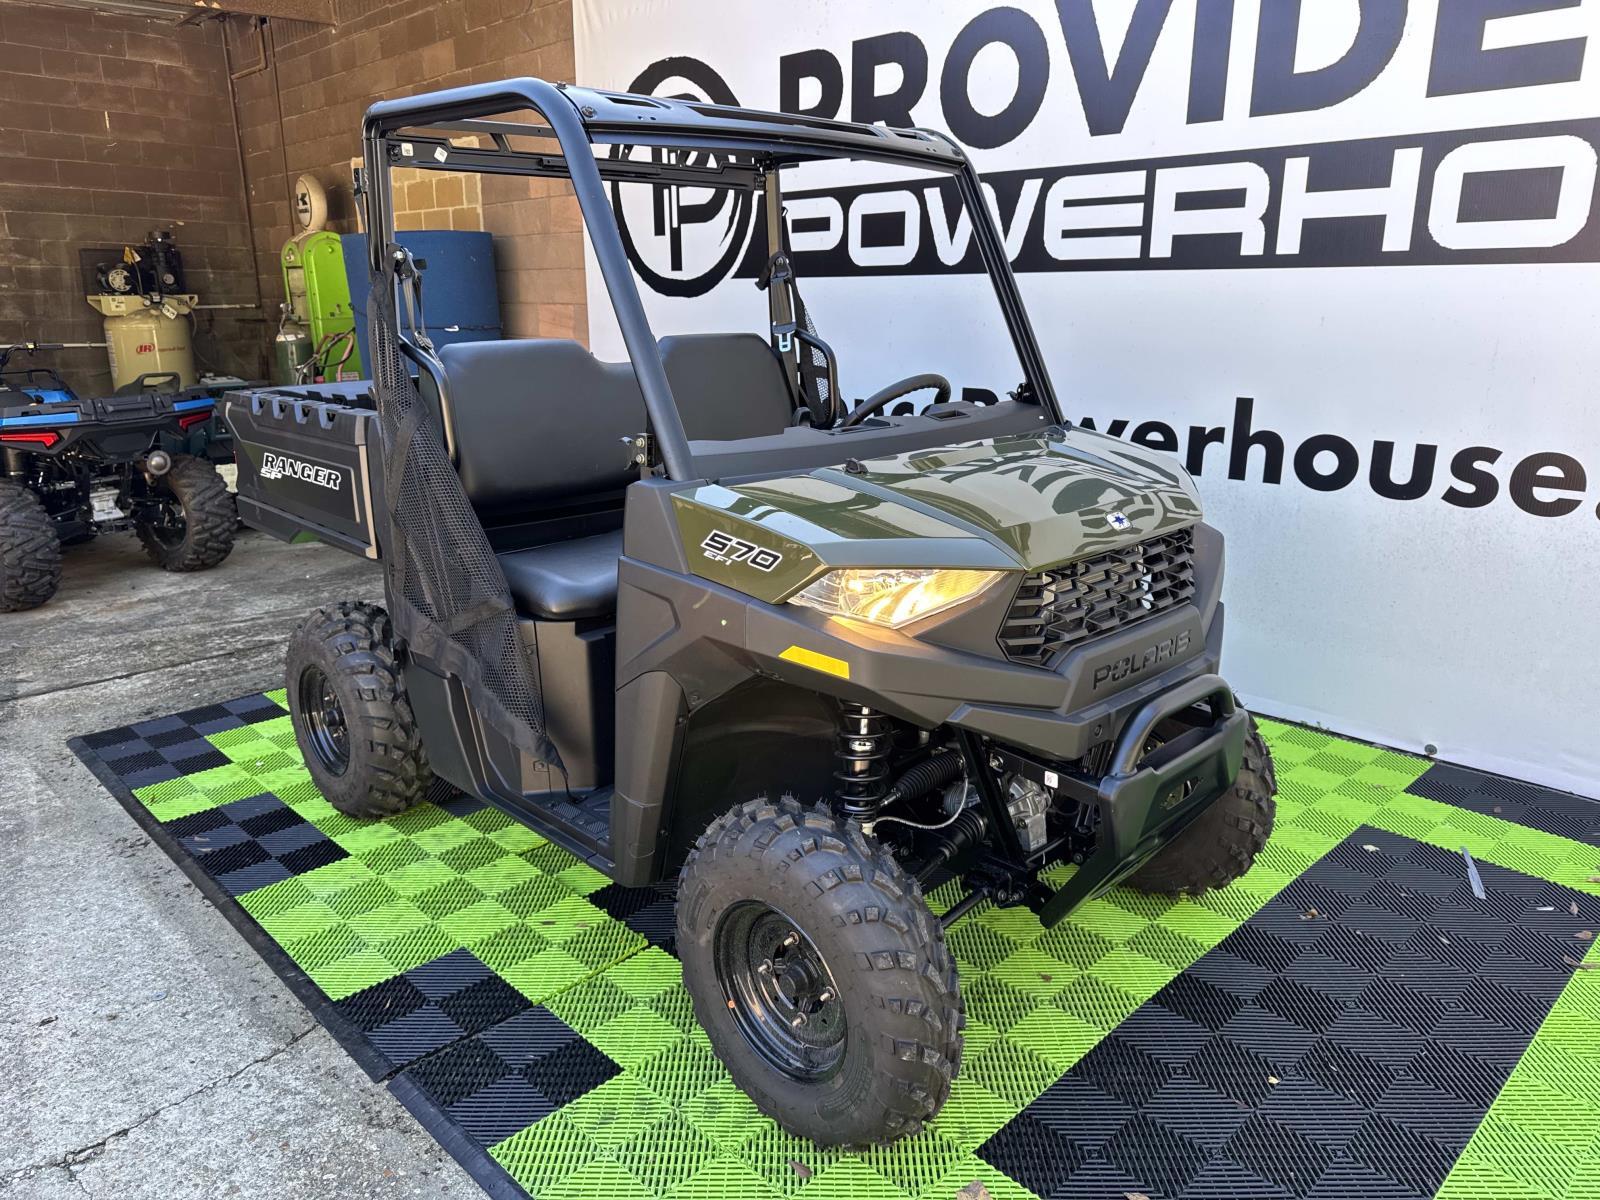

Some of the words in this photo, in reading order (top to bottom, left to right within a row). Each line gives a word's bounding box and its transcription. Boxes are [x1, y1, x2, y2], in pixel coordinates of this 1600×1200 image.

[780, 0, 1588, 168] PROVIDE
[783, 135, 1598, 266] POWERHO
[260, 467, 283, 480] SP
[262, 452, 342, 491] RANGER
[700, 529, 783, 573] 570
[703, 550, 732, 566] EFI
[1092, 628, 1192, 691] POLARIS
